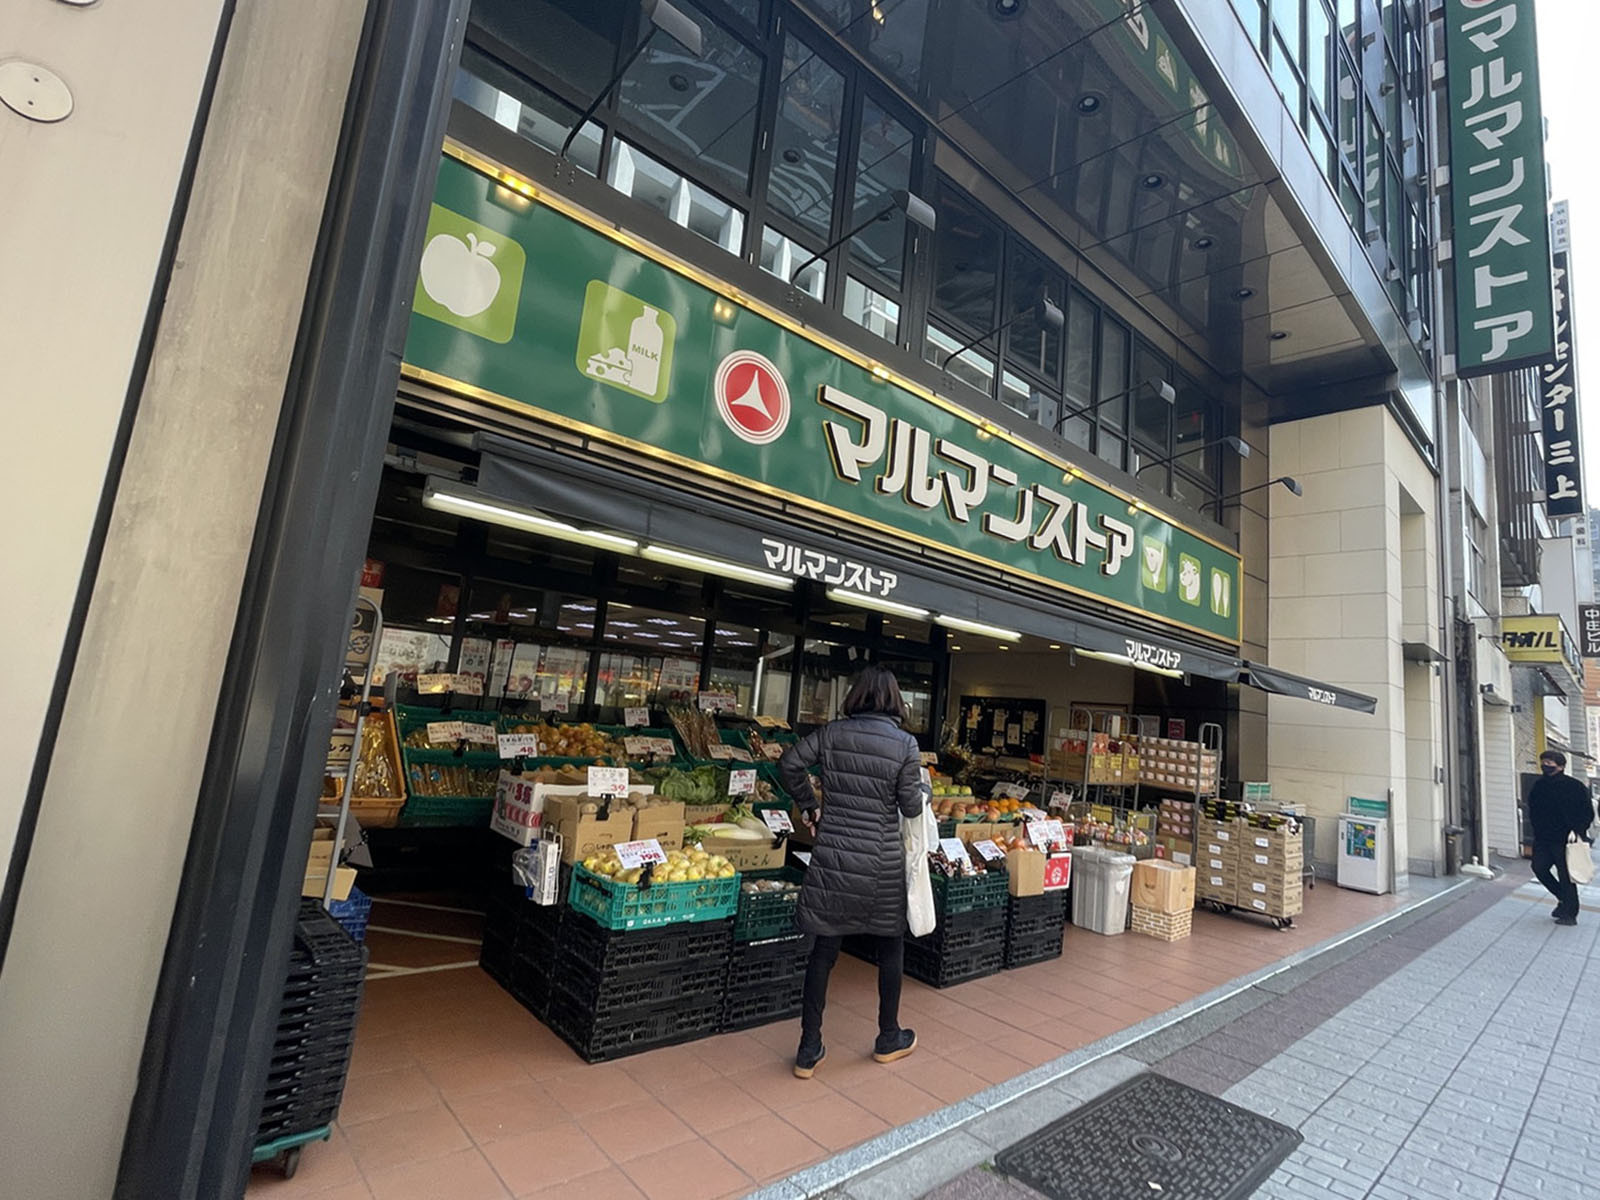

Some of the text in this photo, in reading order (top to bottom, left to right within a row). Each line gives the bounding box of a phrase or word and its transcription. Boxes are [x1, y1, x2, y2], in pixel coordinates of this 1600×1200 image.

[1461, 4, 1533, 361] マルマンストア
[631, 343, 660, 362] MILK
[818, 384, 1135, 576] マルマンストア
[762, 538, 897, 596] マルマンストア
[1125, 640, 1181, 668] マルマンストア
